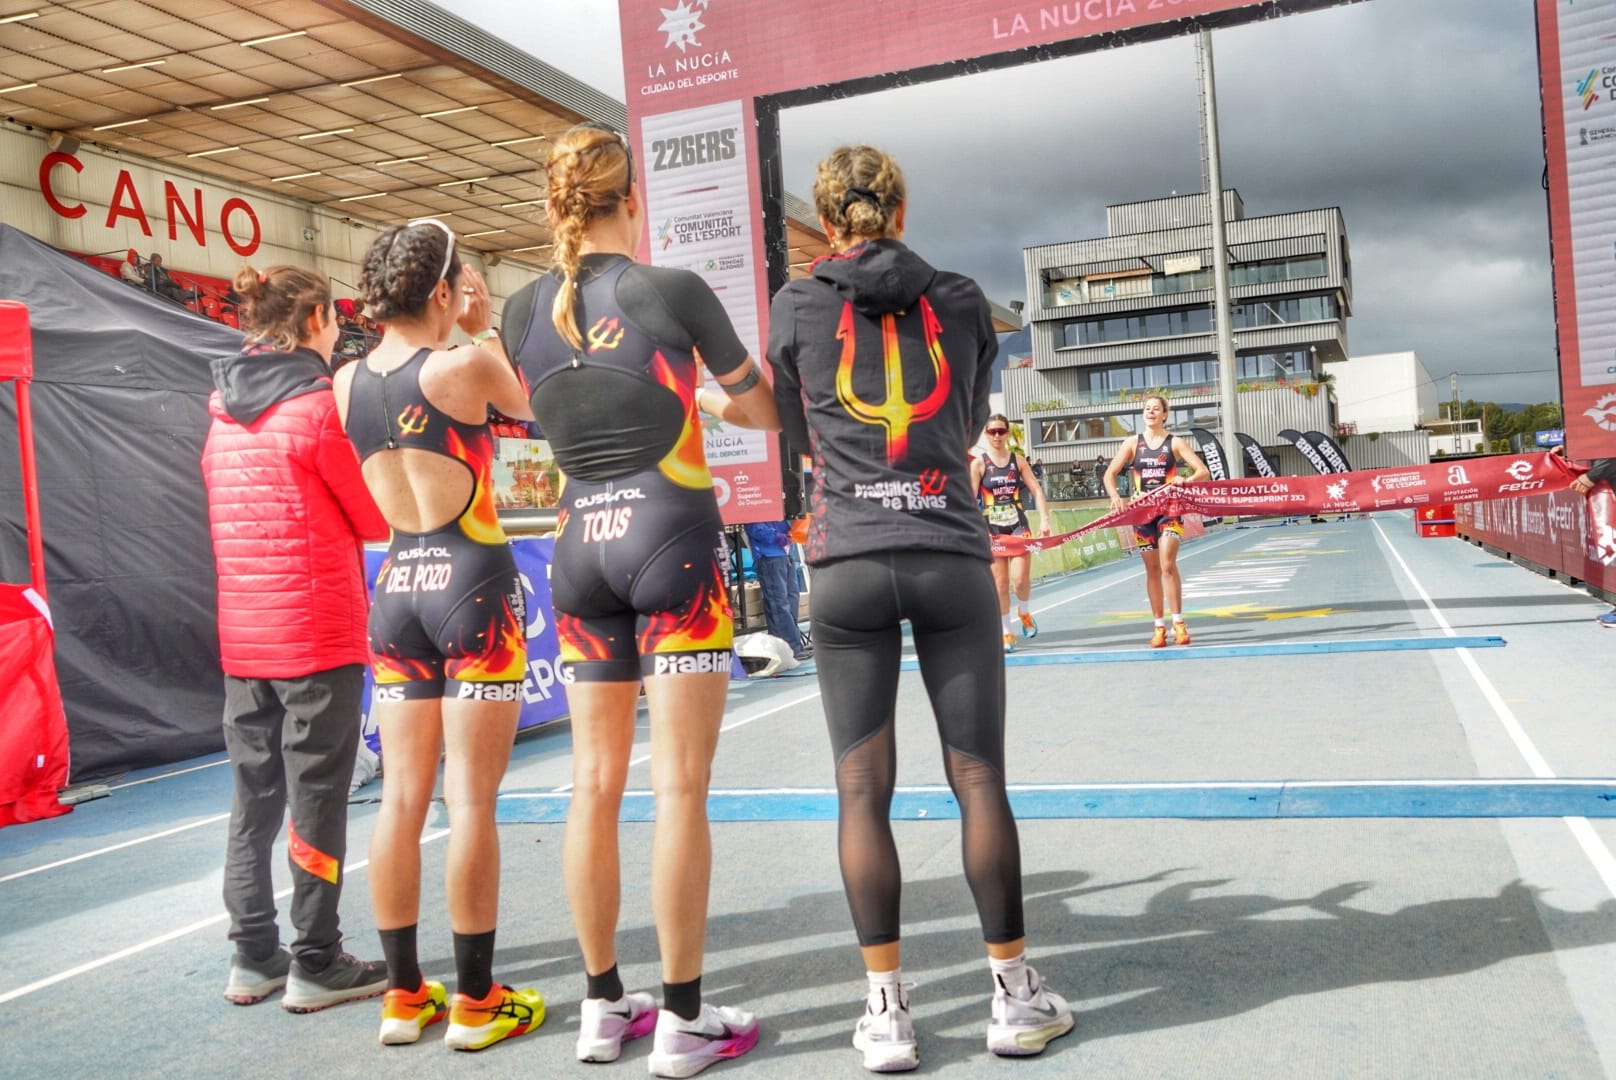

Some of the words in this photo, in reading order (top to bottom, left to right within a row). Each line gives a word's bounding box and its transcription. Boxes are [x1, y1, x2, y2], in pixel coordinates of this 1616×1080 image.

[992, 13, 1030, 39] LA
[640, 81, 675, 95] CIUDAD
[677, 77, 694, 89] DEL
[696, 68, 739, 86] DEPORTE
[648, 63, 666, 78] LA
[652, 127, 737, 172] 226ERS
[39, 151, 261, 257] CANO
[674, 216, 734, 234] COMUNITAT
[679, 233, 693, 244] DE
[695, 225, 742, 242] L'ESPORT
[720, 449, 748, 457] DEPORTE
[1212, 487, 1228, 496] DE
[1231, 482, 1289, 495] DUATLÓN
[1232, 495, 1289, 504] SUPERSPRINT
[583, 506, 632, 543] TOUS
[386, 566, 412, 593] DEL
[413, 563, 452, 591] POZO
